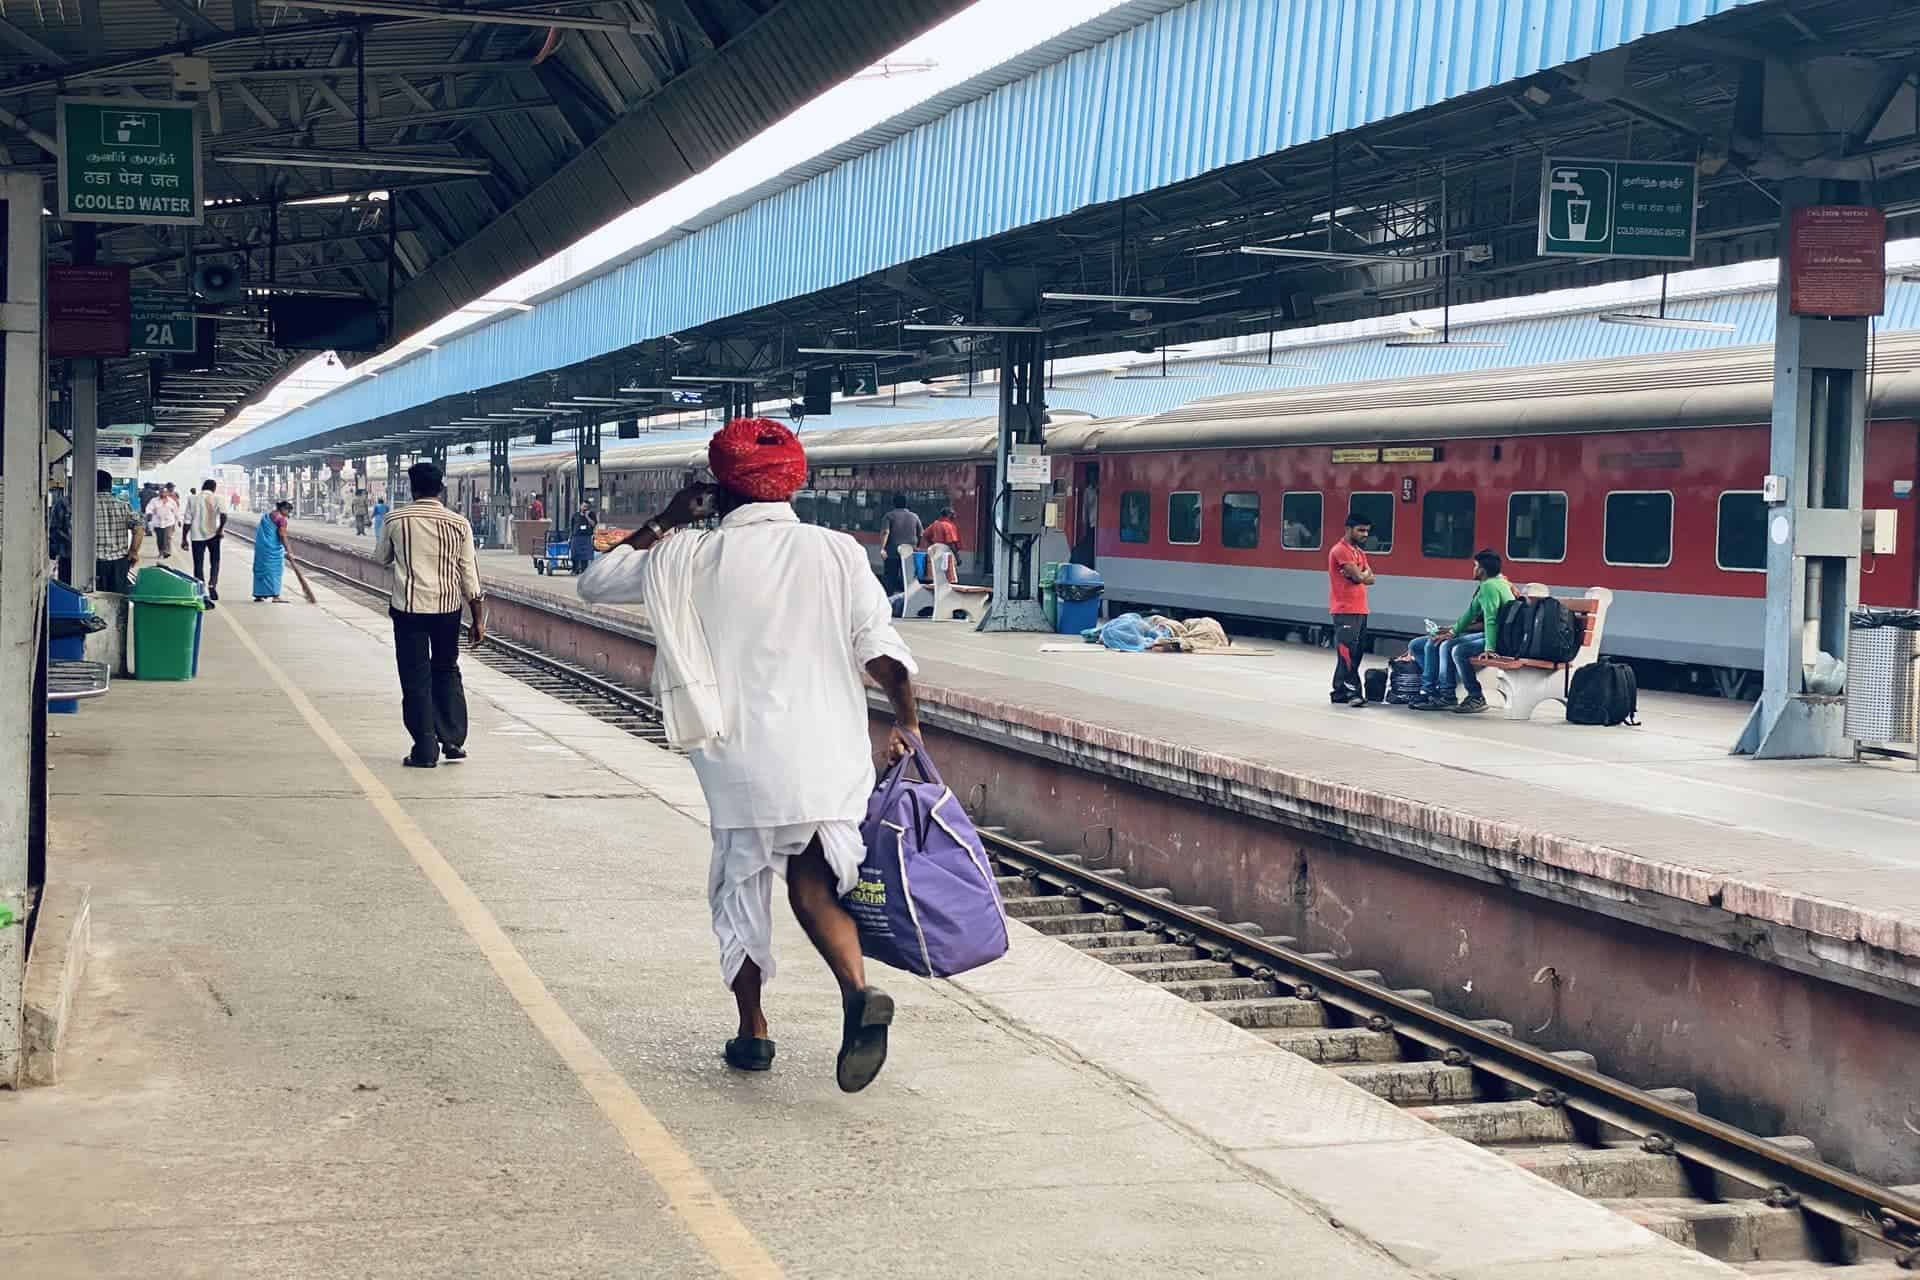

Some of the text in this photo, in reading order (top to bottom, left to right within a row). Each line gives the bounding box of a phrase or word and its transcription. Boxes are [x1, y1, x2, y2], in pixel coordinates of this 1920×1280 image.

[119, 167, 143, 185] पेय
[150, 173, 180, 187] जल
[74, 194, 190, 213] COOLED WATER
[145, 323, 174, 345] 2A
[854, 378, 866, 394] 2
